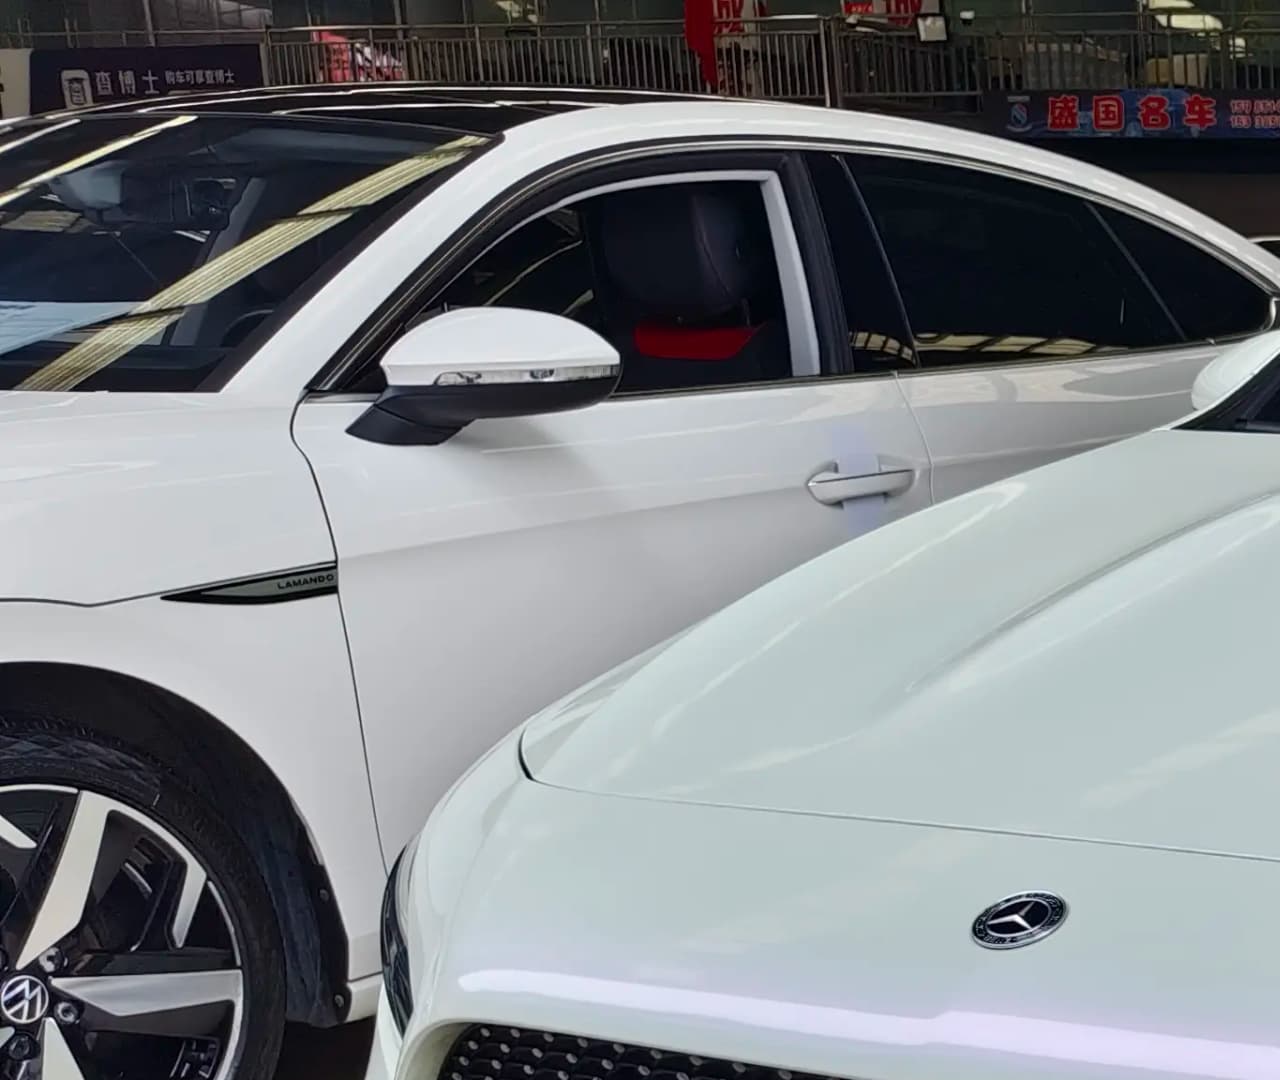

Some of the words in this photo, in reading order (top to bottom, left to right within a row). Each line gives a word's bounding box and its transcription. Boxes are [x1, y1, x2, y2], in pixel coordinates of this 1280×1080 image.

[95, 70, 160, 95] 查博士
[1048, 95, 1217, 131] 盛国名车
[277, 574, 334, 589] LAMANDO
